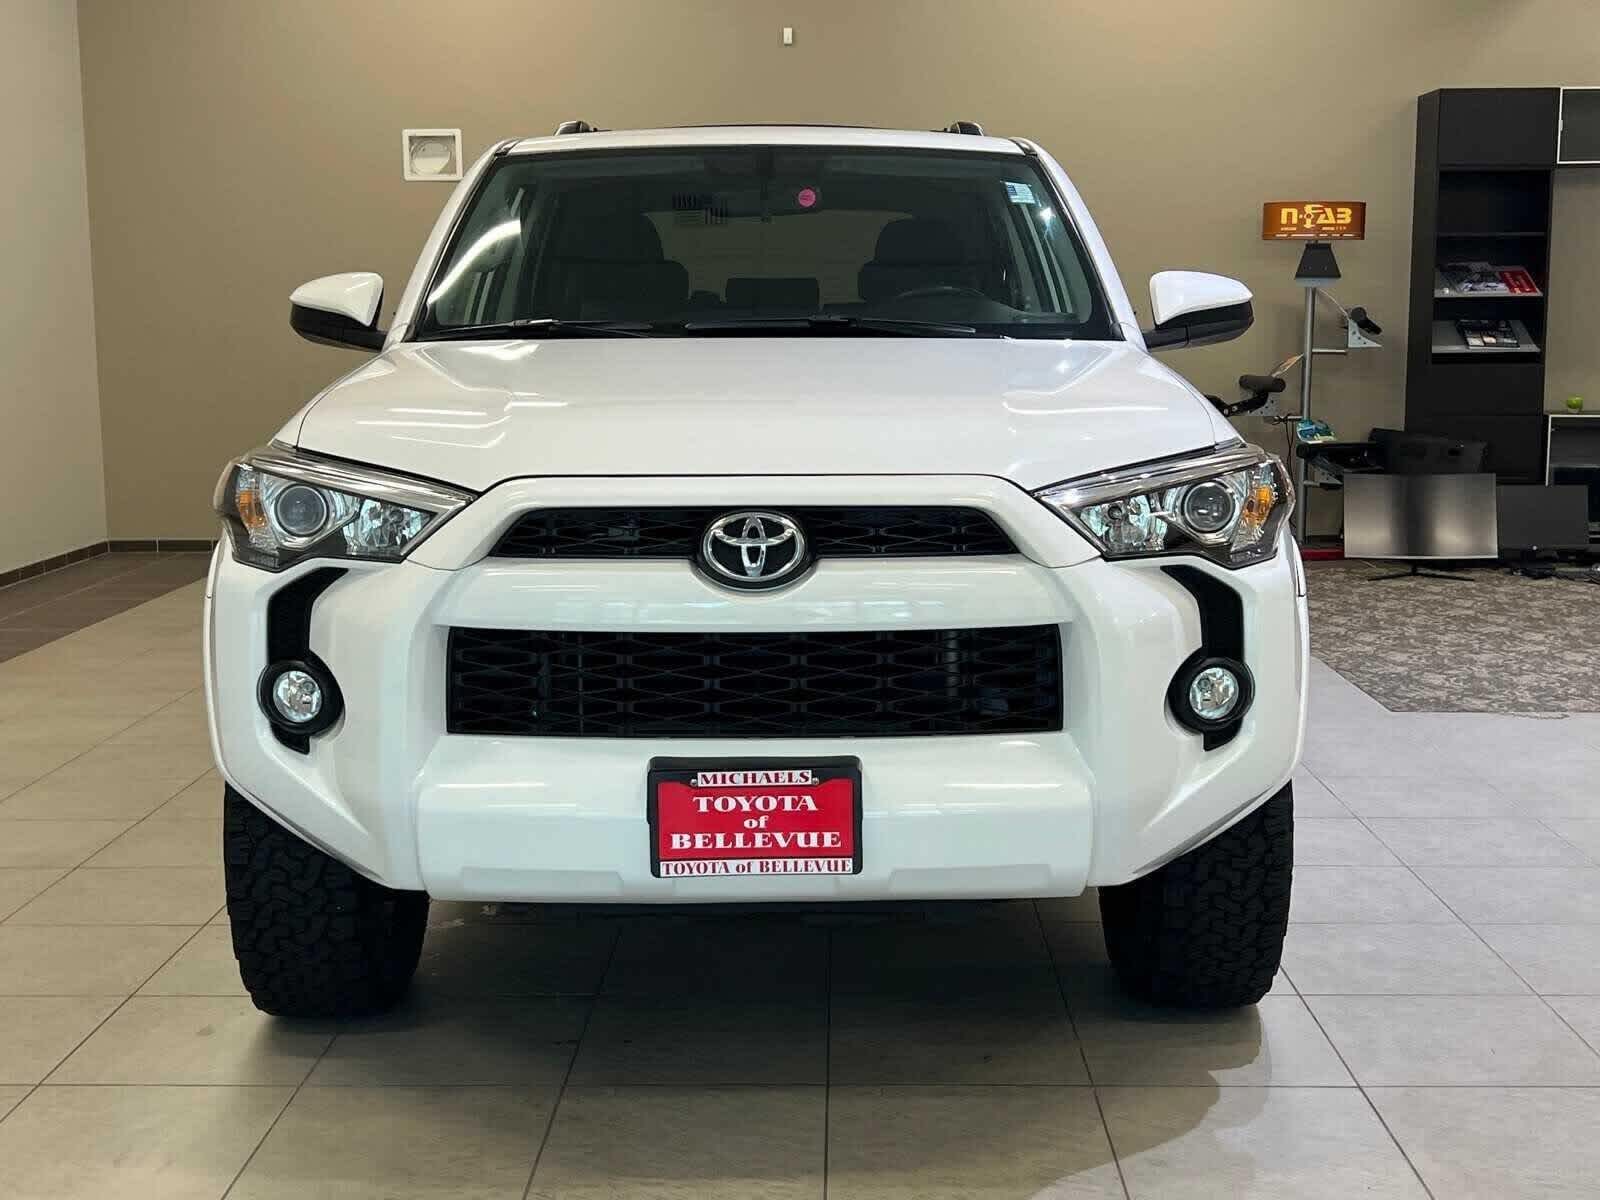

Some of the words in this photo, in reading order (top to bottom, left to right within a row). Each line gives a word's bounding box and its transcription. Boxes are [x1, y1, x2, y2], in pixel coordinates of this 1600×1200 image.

[700, 772, 810, 785] MICHAELS
[693, 795, 818, 813] TOYOTA
[743, 815, 769, 829] of
[671, 831, 841, 849] BELLEVUE
[662, 860, 730, 875] TOYOTA
[735, 860, 754, 873] of
[760, 859, 851, 873] BELLEVUE
